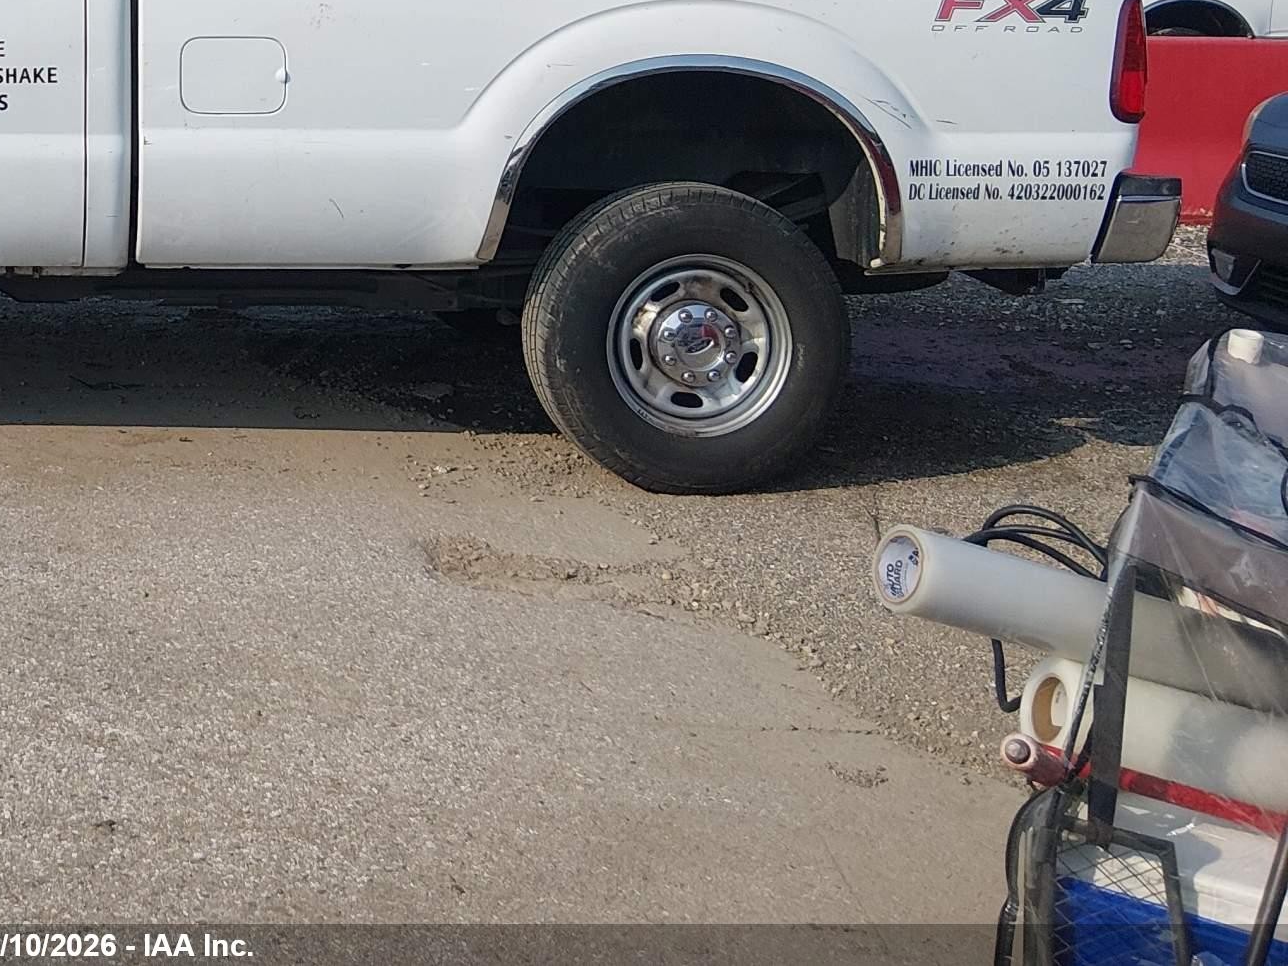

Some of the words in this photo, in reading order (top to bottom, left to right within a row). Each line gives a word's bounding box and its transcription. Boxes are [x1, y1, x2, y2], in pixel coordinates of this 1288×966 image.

[1003, 25, 1083, 33] ROAD
[910, 159, 942, 177] MHIC
[946, 159, 1003, 177] Licensed
[1007, 159, 1028, 177] No.
[1033, 160, 1050, 177] 05
[1056, 160, 1108, 178] 137027
[909, 183, 926, 201] DC
[928, 183, 980, 201] Licensed
[984, 184, 1003, 200] No.
[1007, 184, 1106, 201] 420322000162
